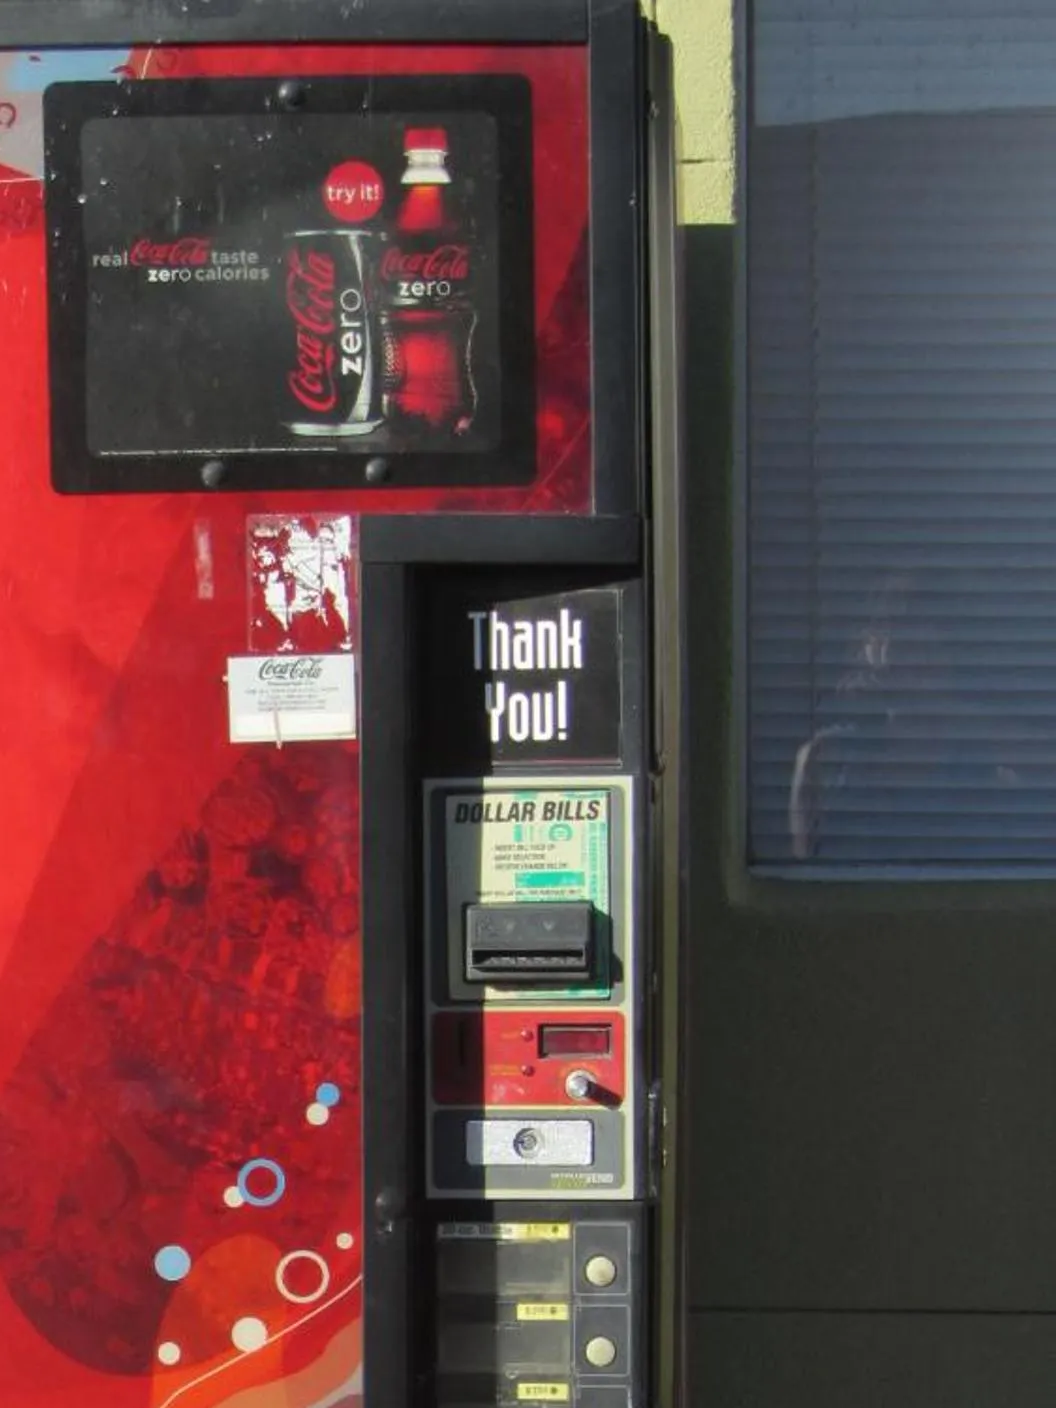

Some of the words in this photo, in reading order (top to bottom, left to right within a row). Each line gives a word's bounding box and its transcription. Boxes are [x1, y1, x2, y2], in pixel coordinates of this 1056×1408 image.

[326, 187, 356, 205] try
[360, 183, 380, 201] it!
[93, 251, 128, 267] real
[212, 250, 259, 265] taste
[380, 244, 472, 280] Coca-Cola
[147, 267, 192, 283] zero
[194, 266, 270, 282] calories
[399, 280, 451, 297] zero
[287, 243, 336, 413] Coca-Cola
[340, 288, 362, 376] zero
[468, 608, 584, 671] Thank
[258, 656, 326, 681] Coca-Cola
[484, 681, 569, 742] You!
[454, 801, 535, 824] DOLLAR
[542, 799, 601, 822] BILLS
